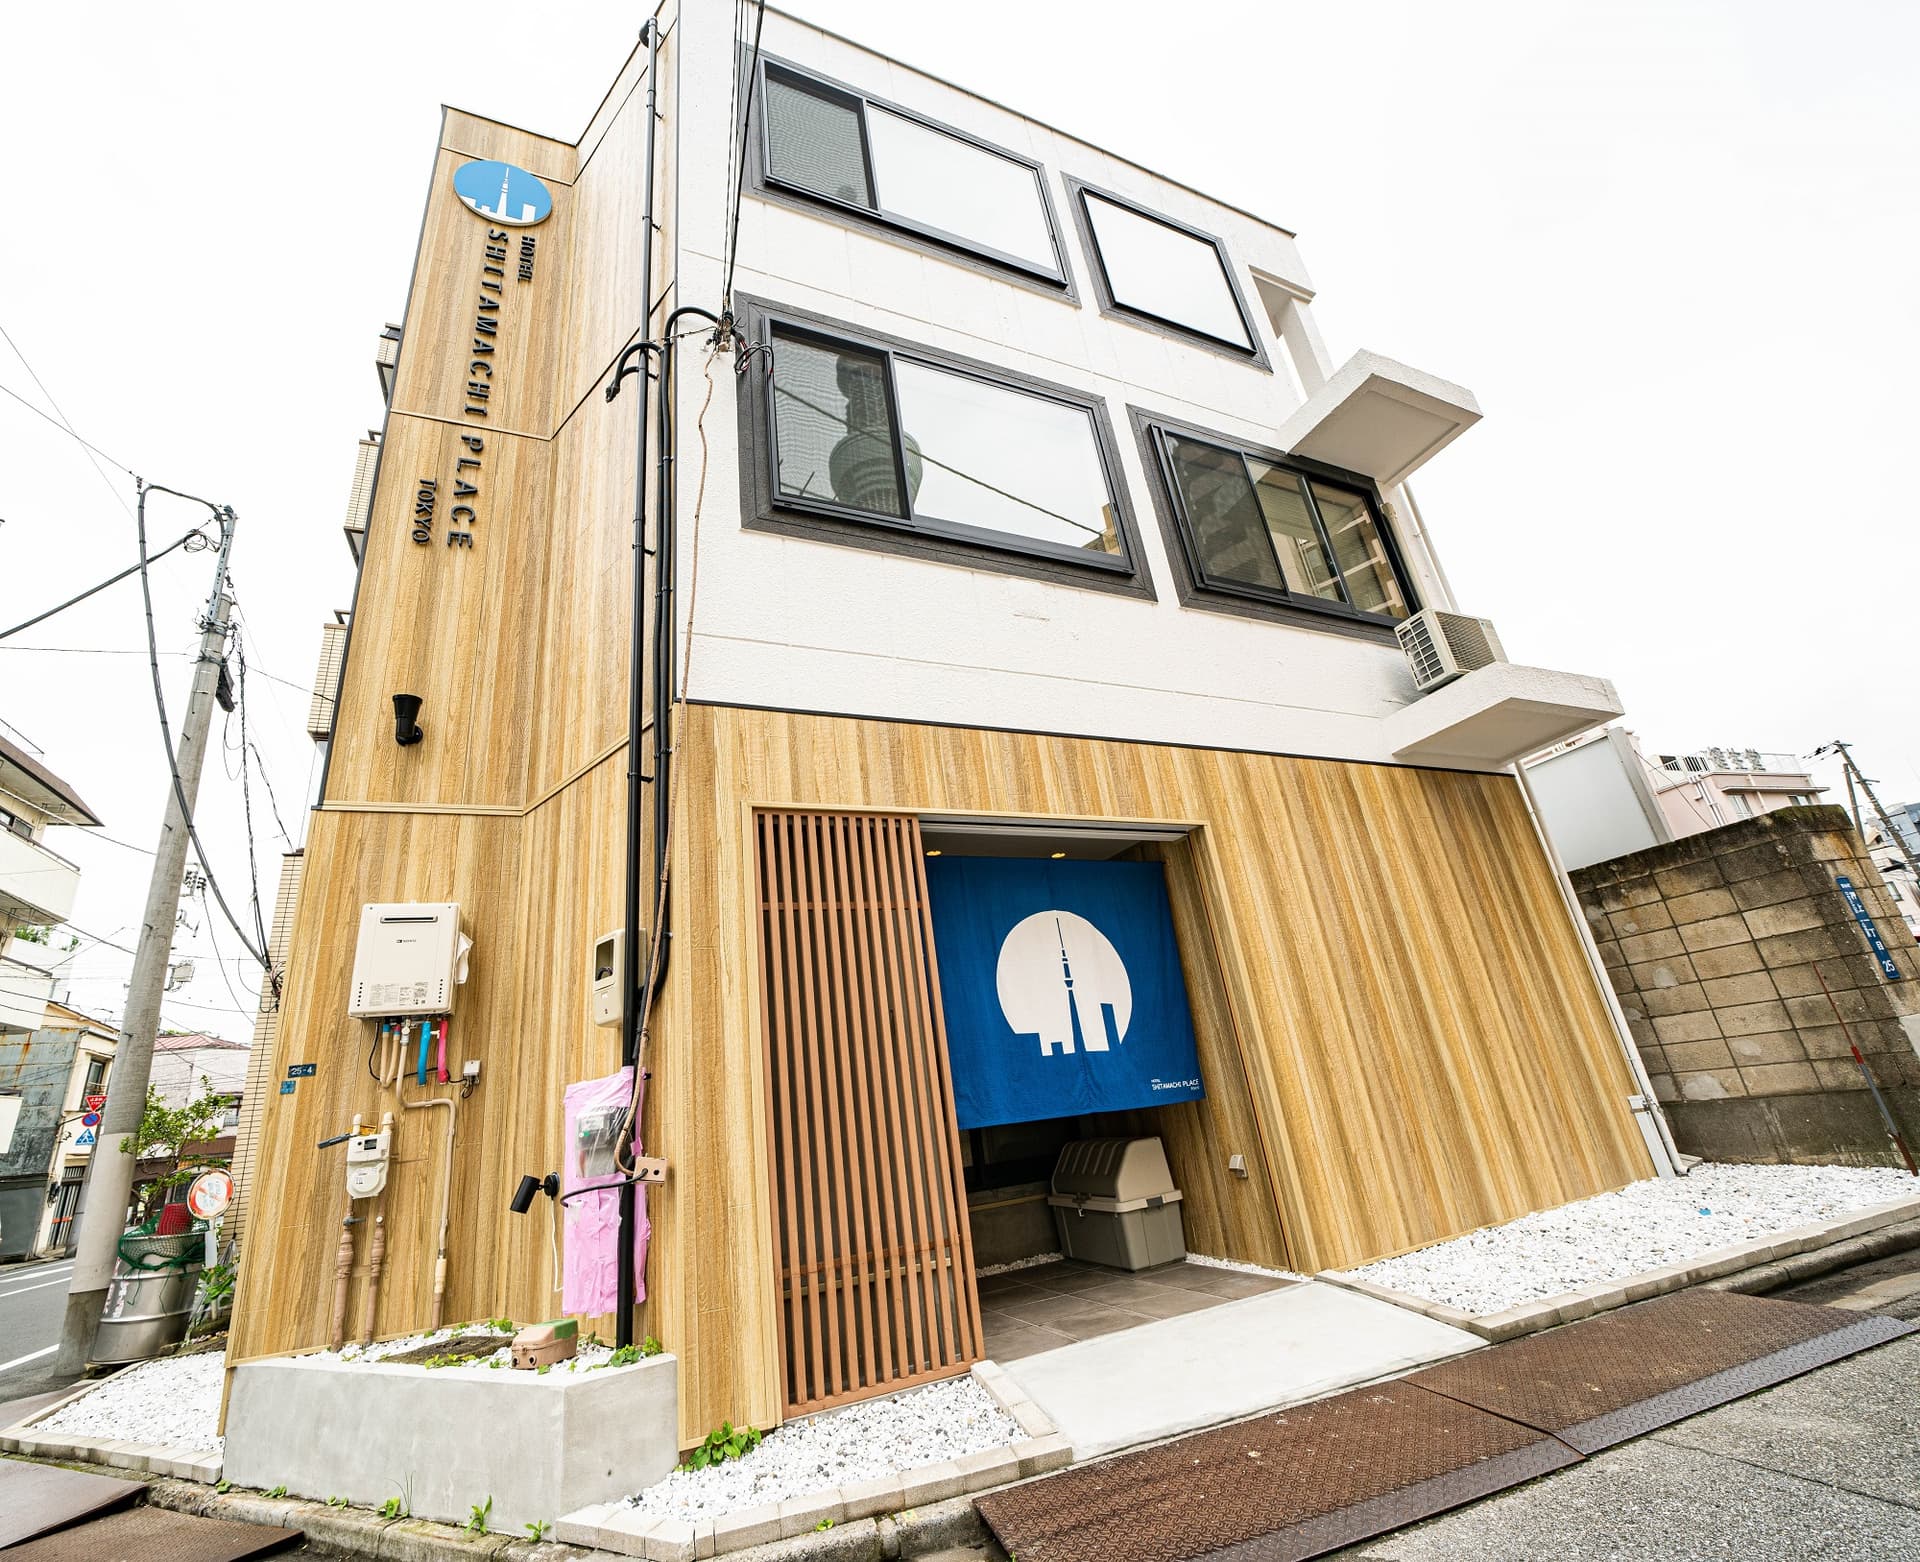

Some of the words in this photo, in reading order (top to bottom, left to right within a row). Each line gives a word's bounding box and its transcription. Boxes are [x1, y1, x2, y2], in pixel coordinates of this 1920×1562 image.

[518, 235, 536, 283] HOTEL
[464, 227, 509, 416] SHITAMACHI
[412, 477, 437, 546] TOKYO
[447, 433, 484, 549] PLACE
[1881, 959, 1896, 973] 25
[1182, 1079, 1199, 1088] PLACE
